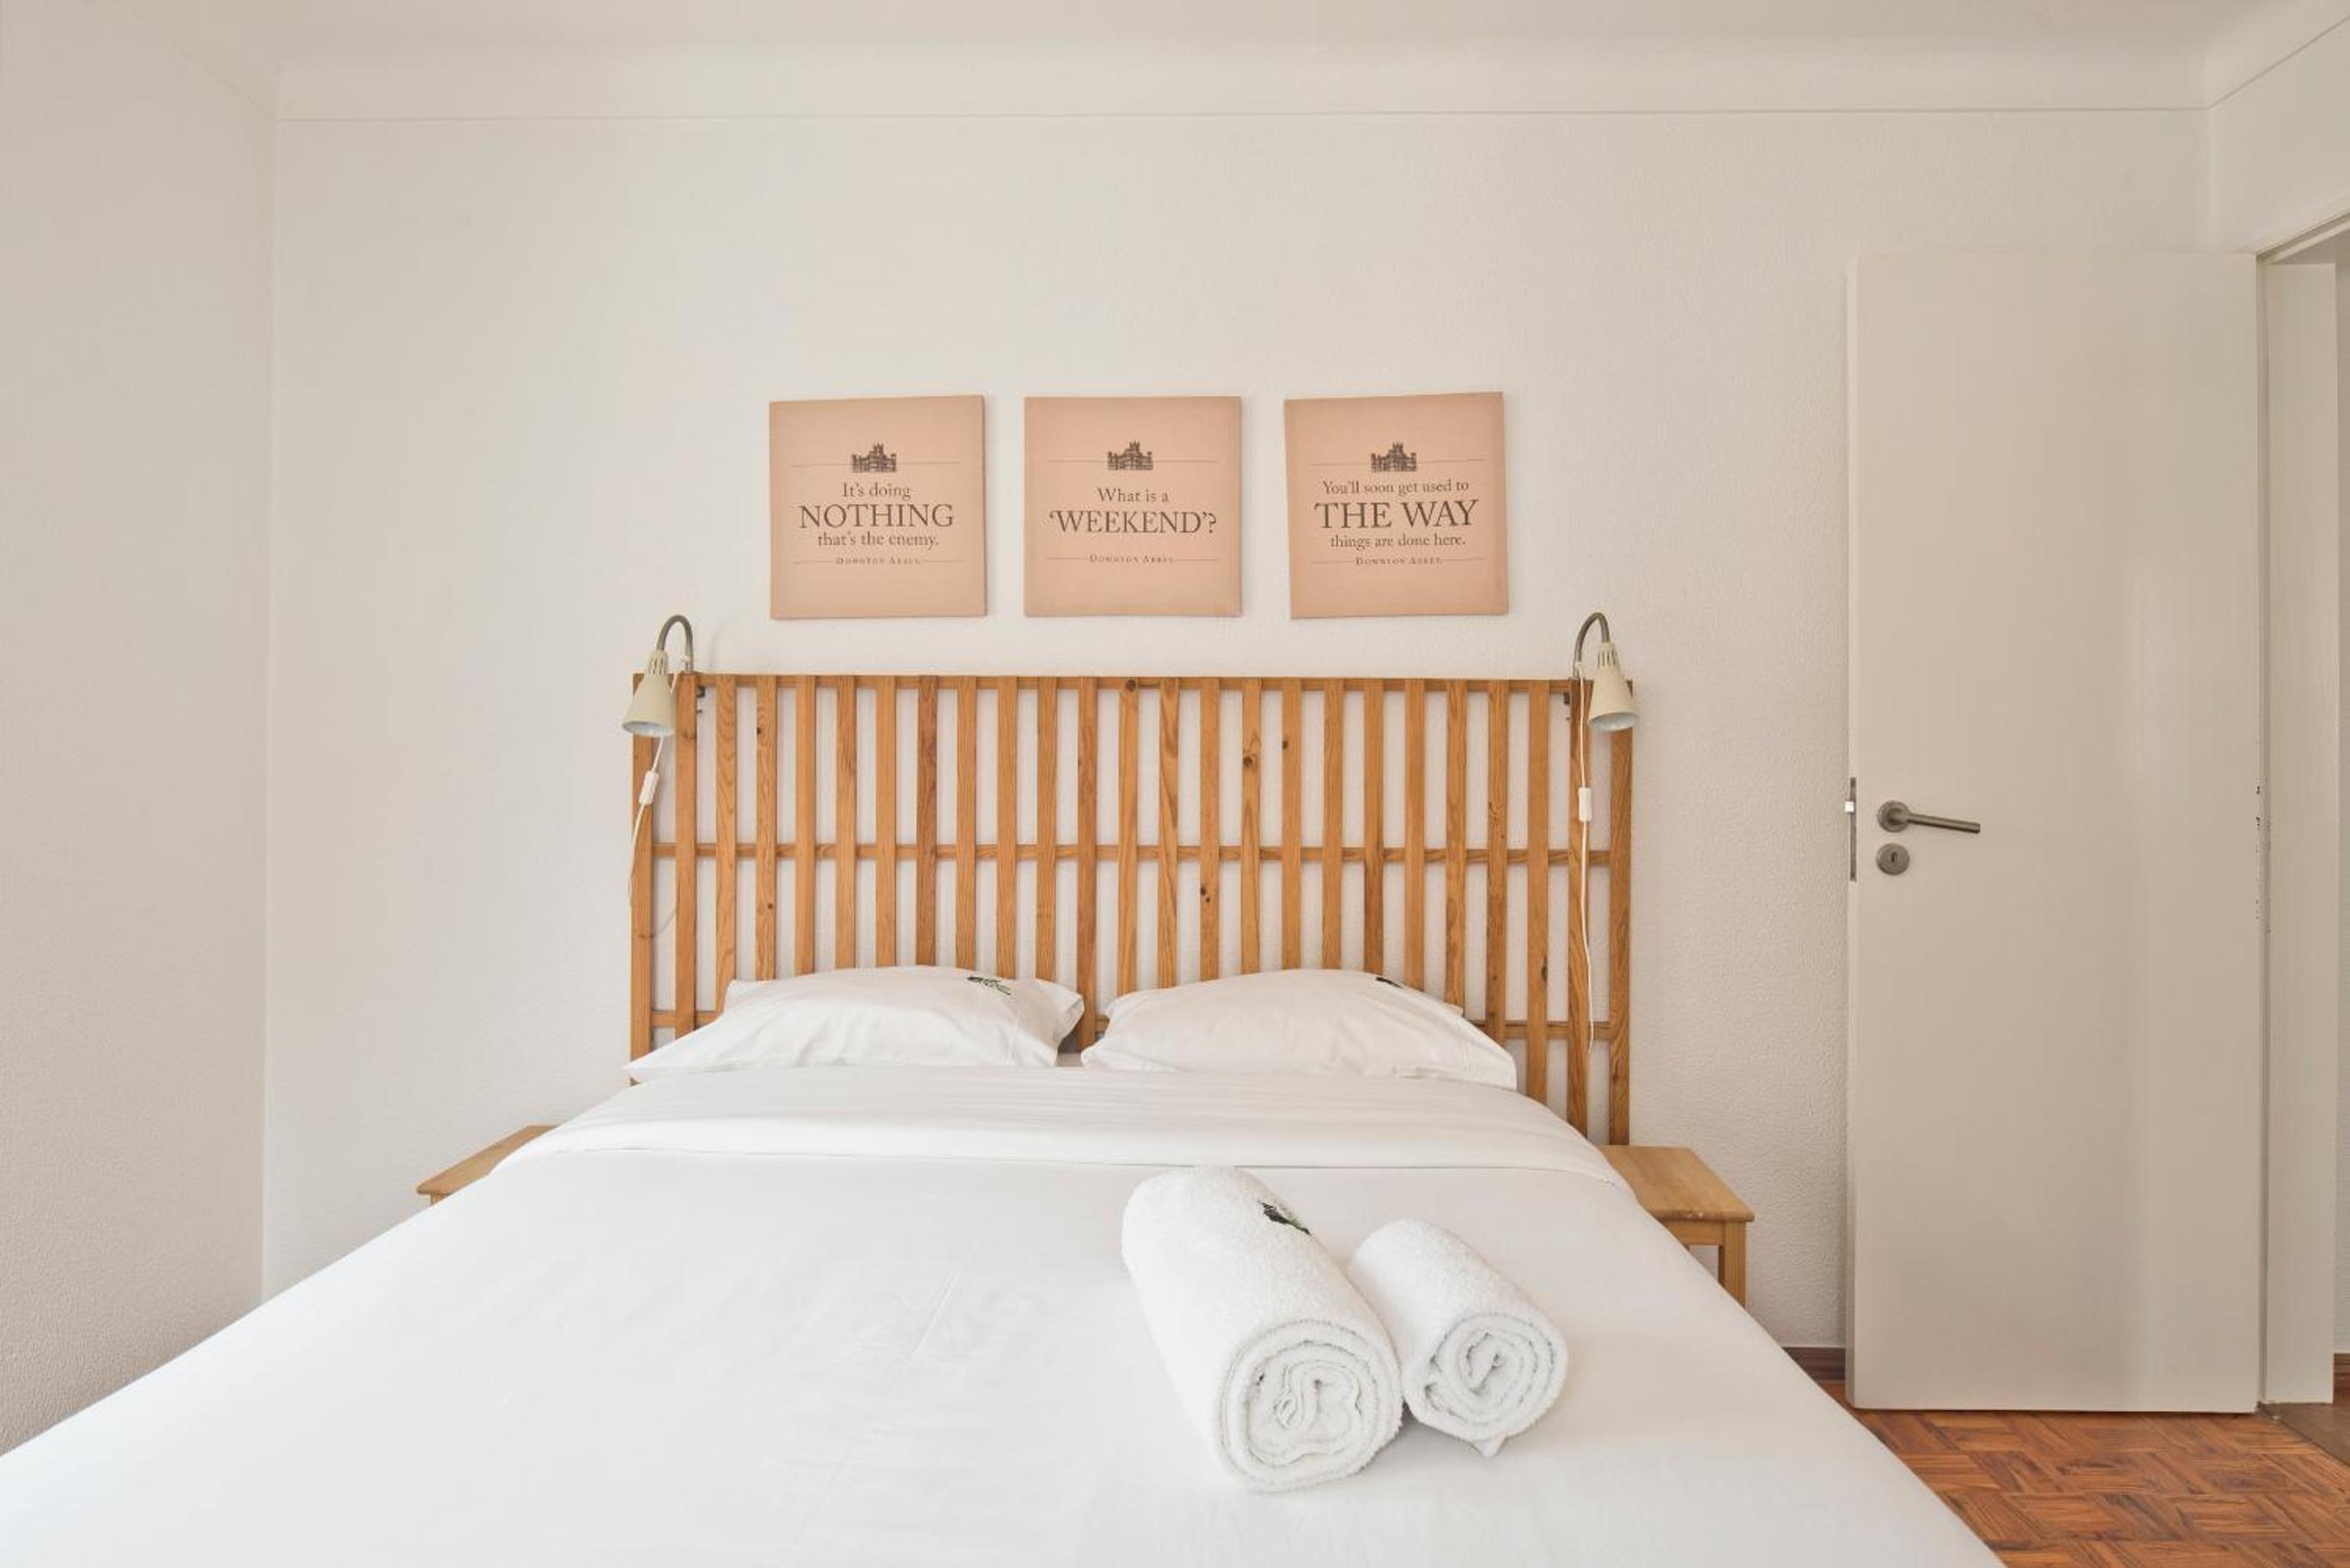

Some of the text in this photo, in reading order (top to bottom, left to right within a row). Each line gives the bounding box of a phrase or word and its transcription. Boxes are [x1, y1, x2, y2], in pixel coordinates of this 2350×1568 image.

[842, 482, 911, 500] It's doing
[1097, 488, 1170, 502] What is a
[1323, 478, 1469, 496] You'll soon get used to
[799, 504, 954, 528] NOTHING
[1314, 499, 1479, 528] THE WAY
[818, 532, 940, 550] that's the enemy.
[1330, 532, 1466, 550] things are done here.
